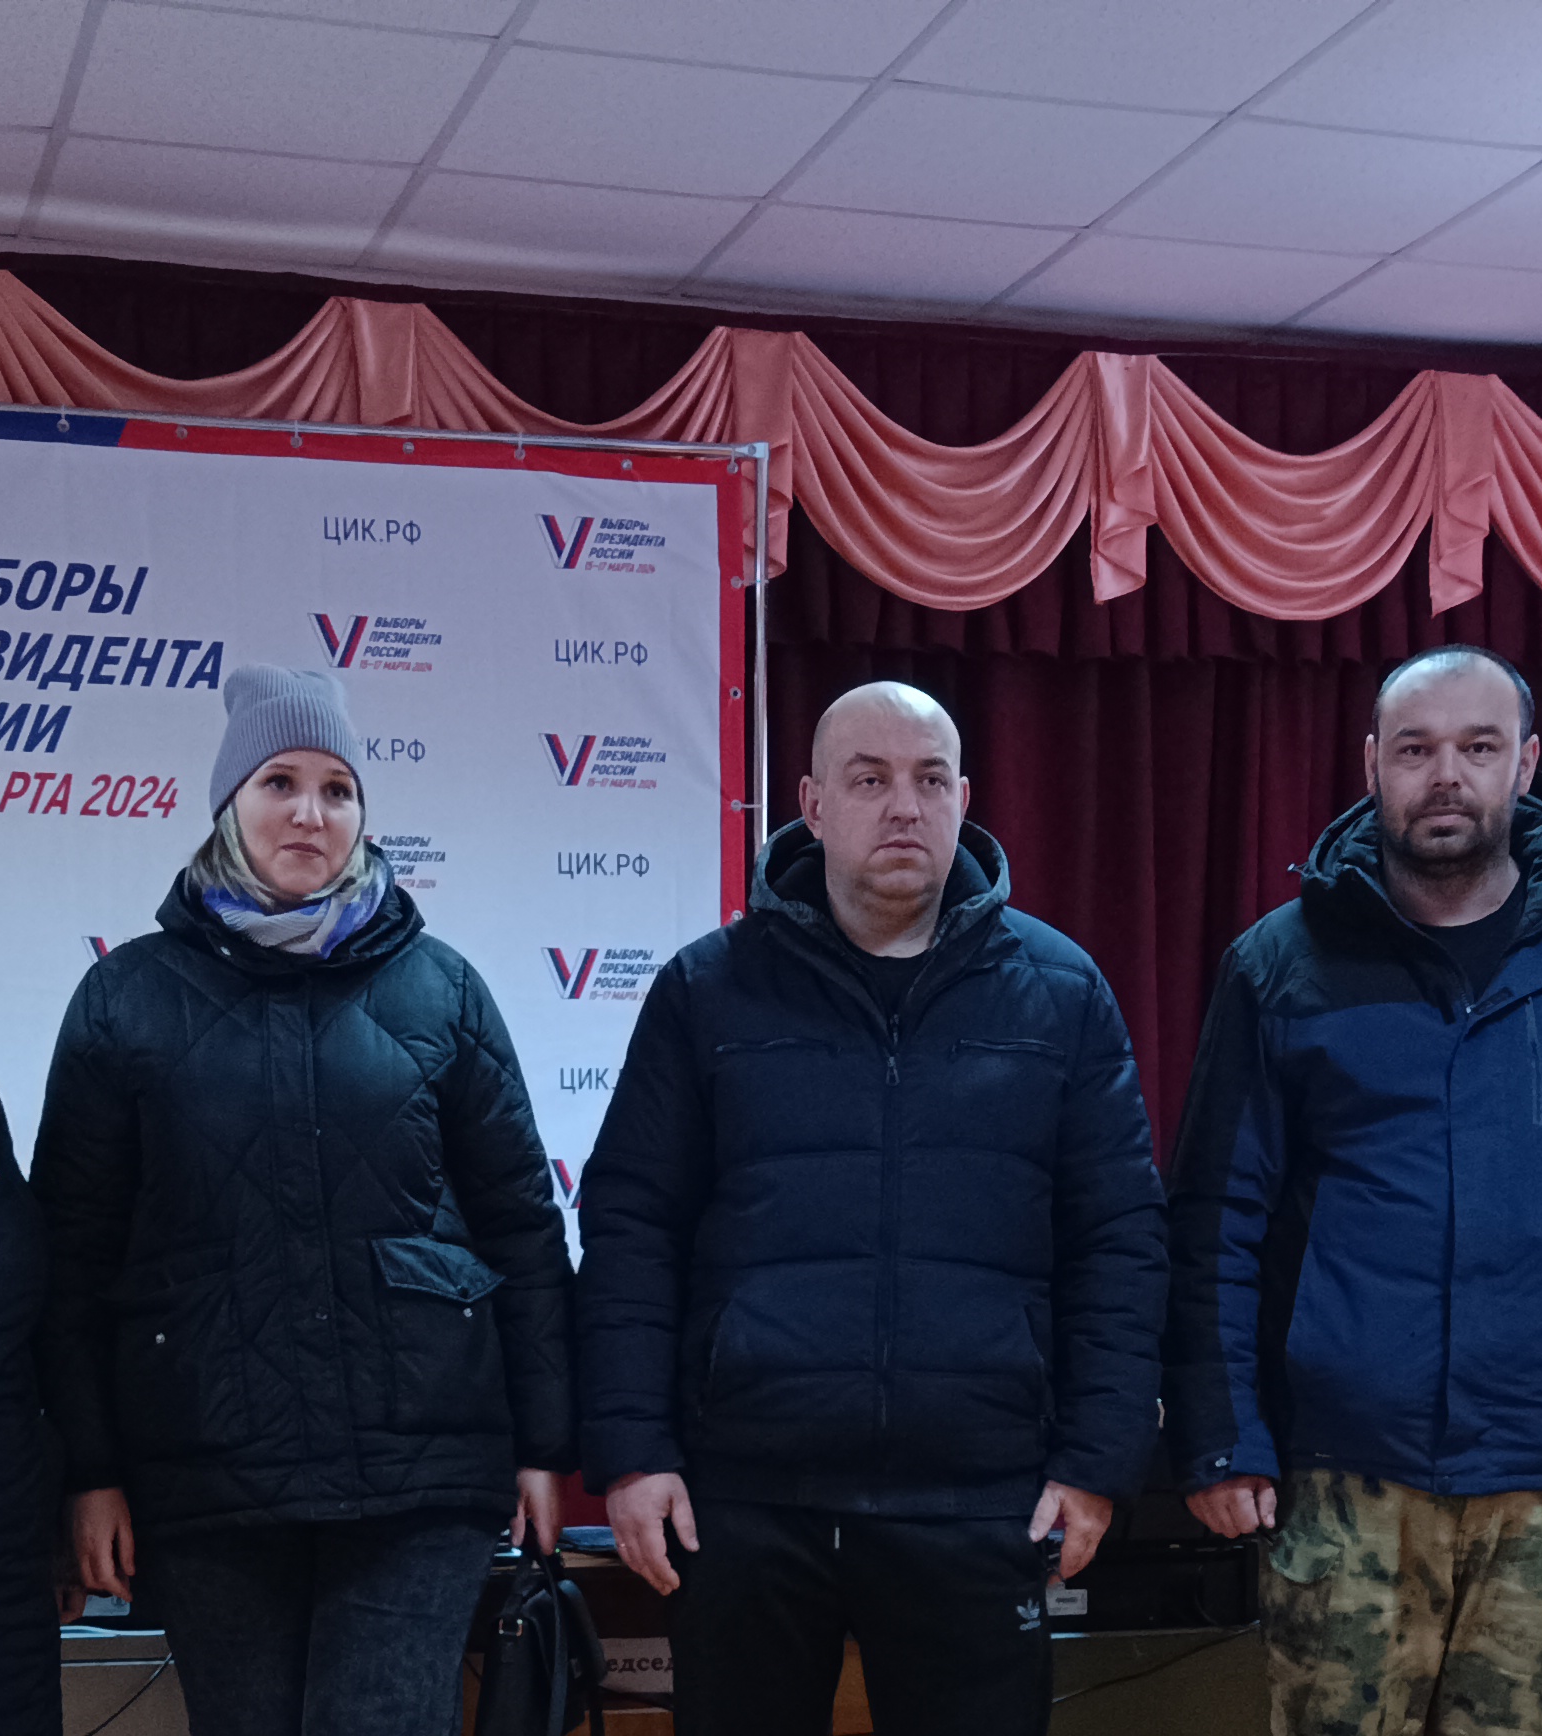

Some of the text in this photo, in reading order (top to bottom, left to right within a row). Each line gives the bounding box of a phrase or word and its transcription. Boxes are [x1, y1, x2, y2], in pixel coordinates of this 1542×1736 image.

[600, 518, 649, 530] ВЫБОРЫ
[324, 517, 421, 545] ЦИК.РФ
[595, 533, 665, 547] ПРЕЗИДЕНТА
[589, 547, 634, 559] РОССИИ
[375, 617, 426, 629] ВЫБОРЫ
[369, 631, 442, 645] ПРЕЗИДЕНТА
[364, 646, 410, 657] РОССИИ
[555, 640, 647, 666] ЦИК.РФ
[602, 736, 651, 748] ВЫБОРЫ
[366, 738, 425, 763] К.РФ
[597, 750, 666, 763] ПРЕЗИДЕНТА
[591, 764, 636, 775] РОССИИ
[80, 774, 178, 818] 2024
[380, 836, 431, 847] ВЫБОРЫ
[383, 850, 445, 862] РЕЗИДЕНТА
[558, 852, 649, 879] ЦИК.РФ
[604, 949, 654, 961] ВЫБОРЫ
[593, 977, 638, 989] РОССИИ
